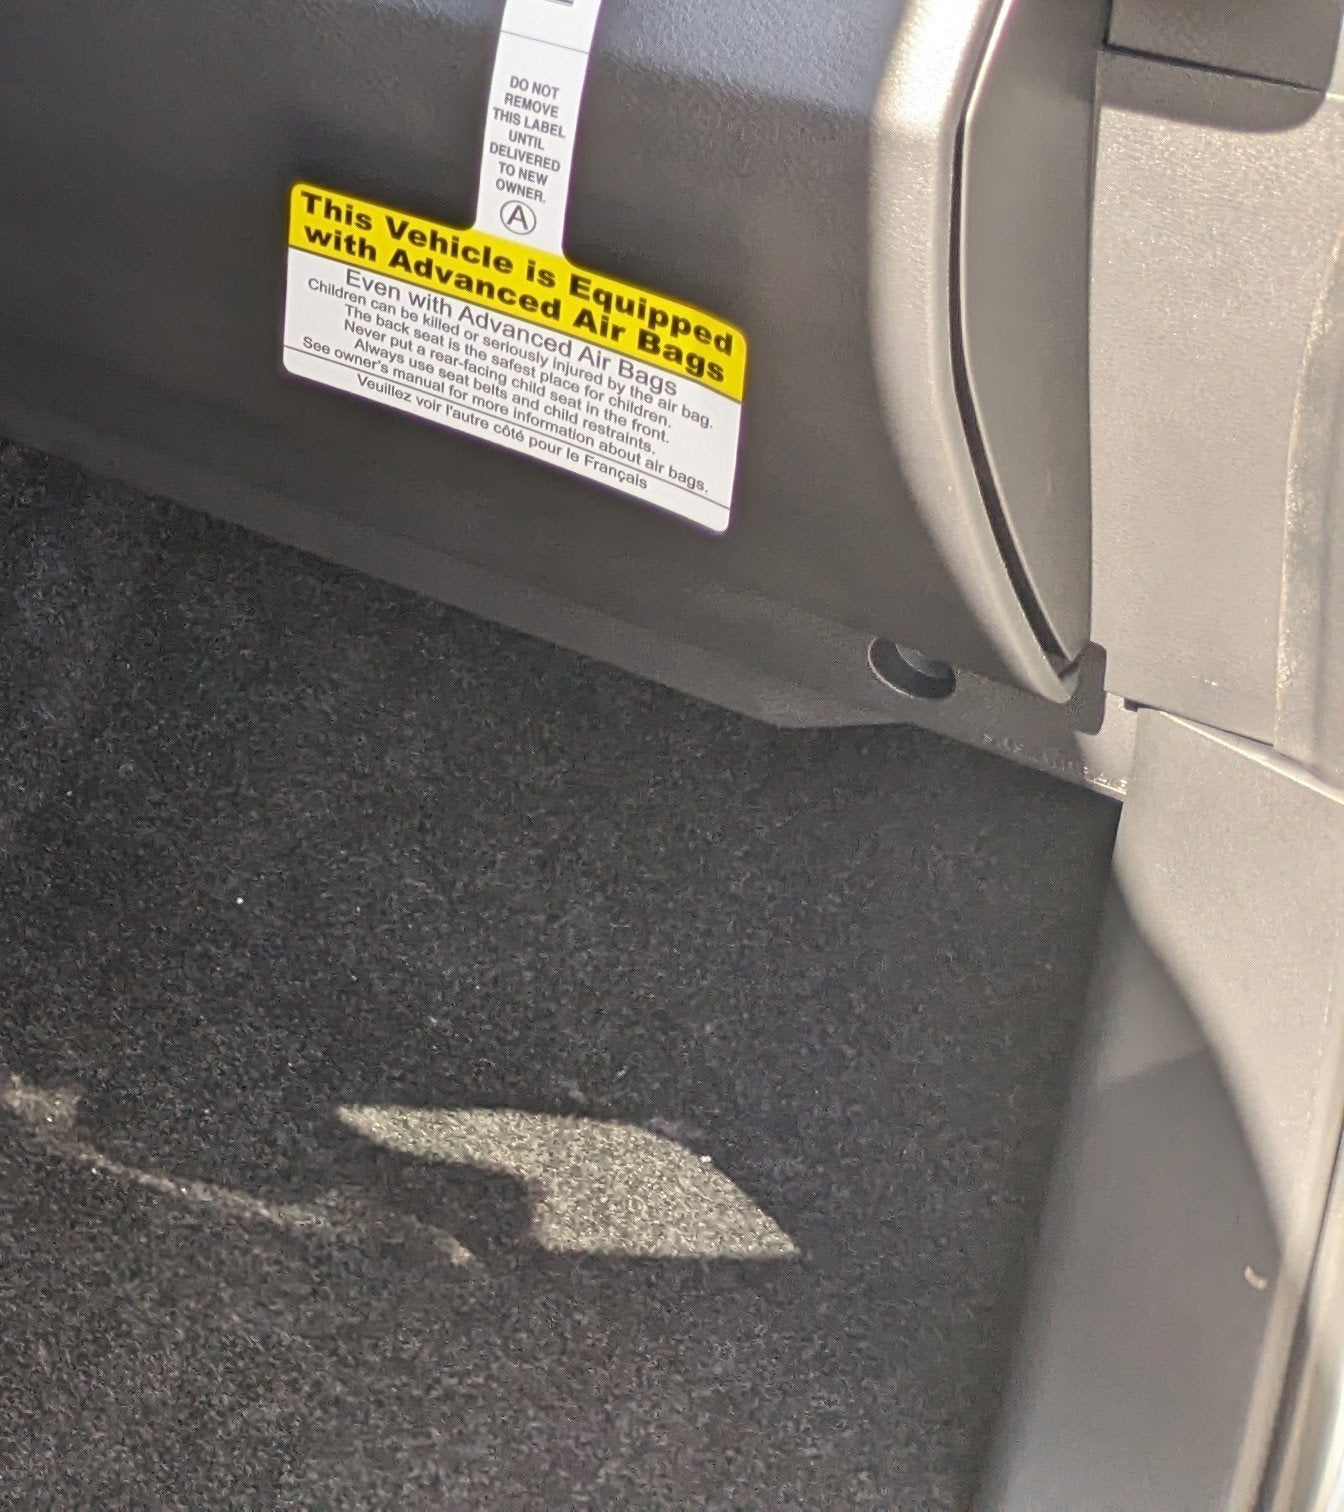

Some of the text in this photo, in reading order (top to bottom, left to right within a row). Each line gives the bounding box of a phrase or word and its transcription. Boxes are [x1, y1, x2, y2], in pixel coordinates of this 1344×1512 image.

[493, 107, 566, 138] THIS LABEL
[504, 92, 559, 118] REMOVE
[508, 130, 545, 150] UNTIL
[510, 75, 560, 99] DO NOT
[489, 142, 561, 173] DELIVERED
[495, 178, 546, 203] OWNER.
[499, 161, 548, 186] TO NEW
[301, 190, 733, 357] This Vehicle is Equipped
[304, 225, 724, 382] with Advanced Air Bags
[346, 267, 677, 396] Even with Advanced Air Bags
[308, 277, 714, 429] Children can be killed or seriously injured by the air bag.
[344, 304, 672, 428] The back seat is the safest place for children.
[344, 319, 670, 444] Never put a rear-facing child seat in the front.
[354, 338, 656, 455] Always use seat belts and child restraints.
[302, 336, 709, 494] See owner's manual for more information about air bags.
[356, 373, 648, 490] Veuillez voir l'autre côté pour le Français
